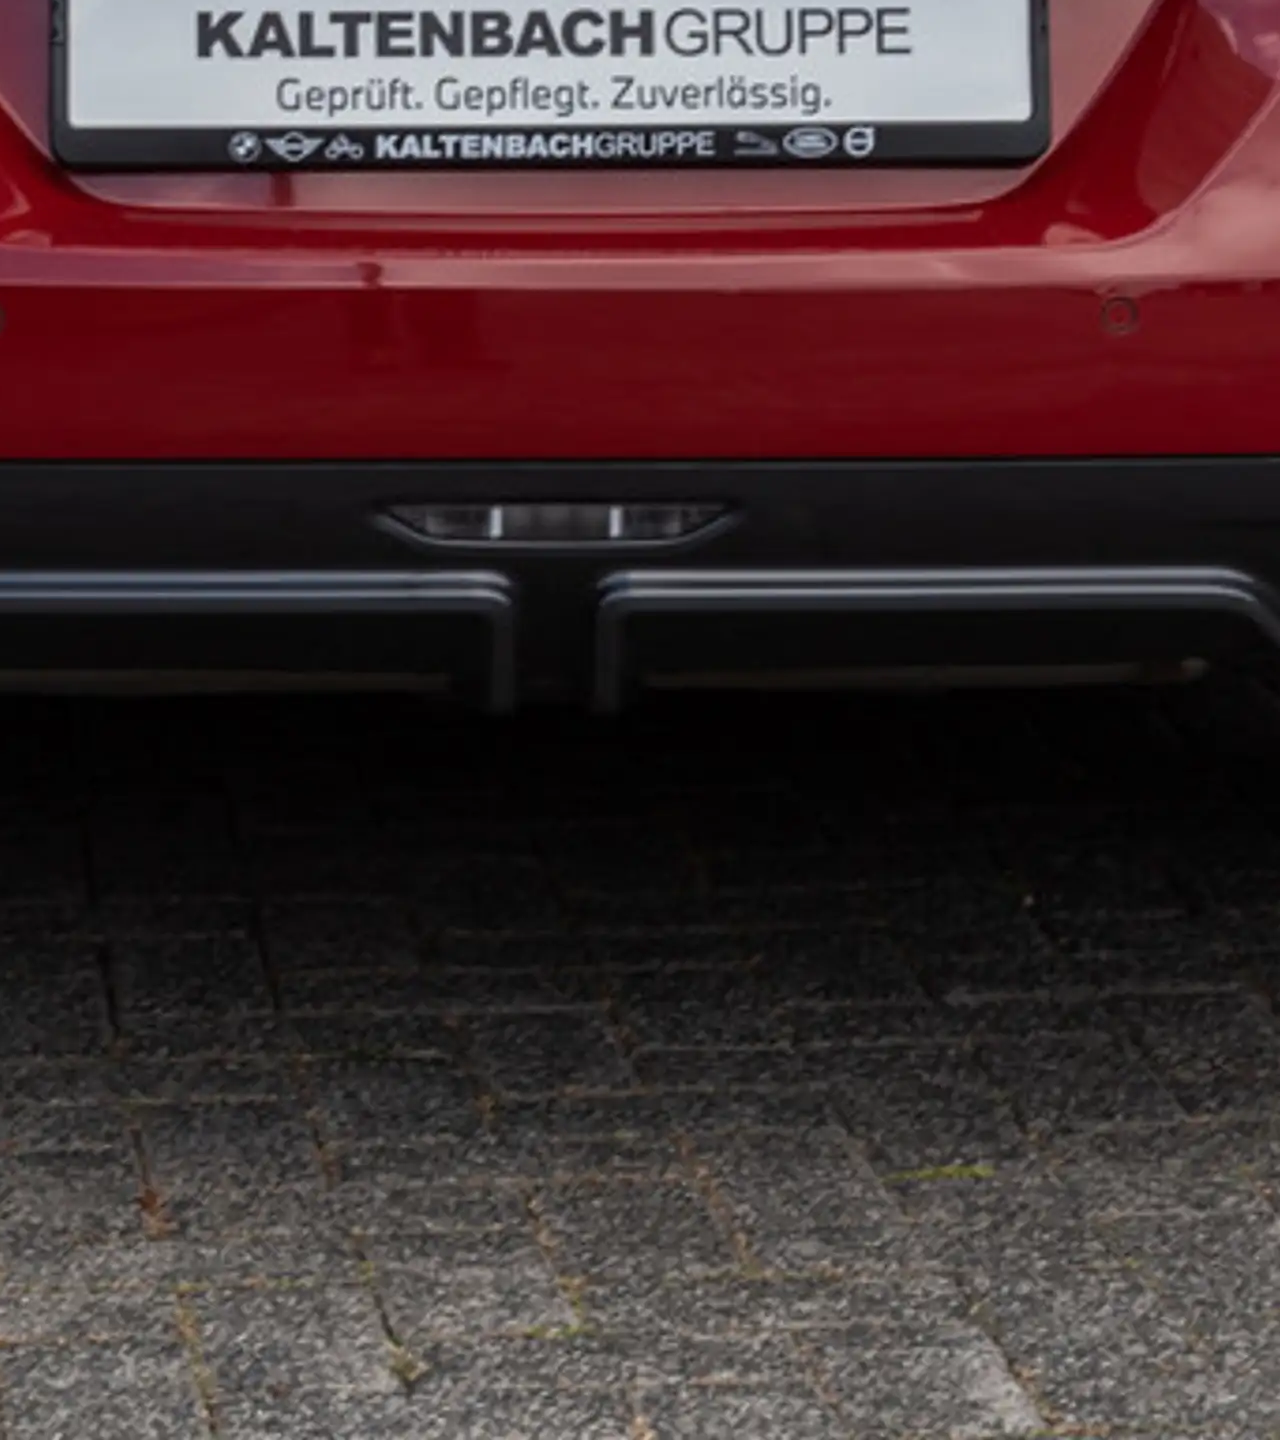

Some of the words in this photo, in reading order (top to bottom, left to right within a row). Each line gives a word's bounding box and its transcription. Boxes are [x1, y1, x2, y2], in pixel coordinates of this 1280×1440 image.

[275, 76, 424, 116] Geprüft.
[434, 75, 600, 117] Gepflegt.
[610, 73, 833, 115] Zuverlässig.
